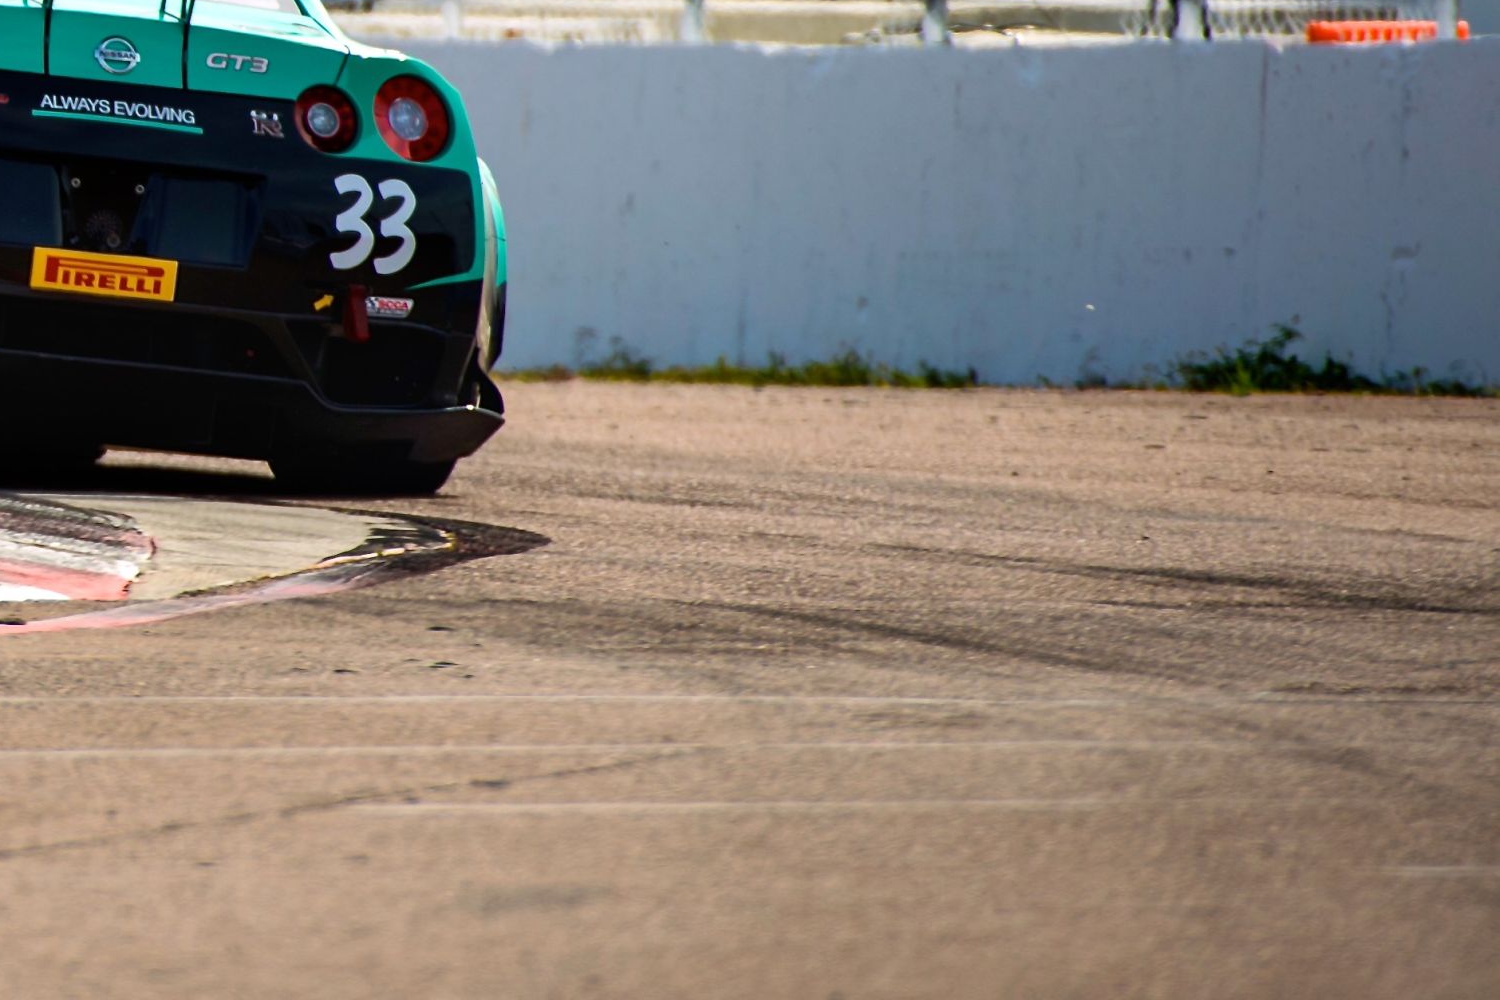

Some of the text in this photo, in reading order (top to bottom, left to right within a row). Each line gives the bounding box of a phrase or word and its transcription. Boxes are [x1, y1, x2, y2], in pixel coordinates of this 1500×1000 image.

[99, 49, 137, 61] NISSAN
[205, 52, 269, 74] GT3
[40, 94, 196, 125] ALWAYS EVOLVING
[329, 173, 417, 275] 33
[44, 254, 166, 295] PIRELLI
